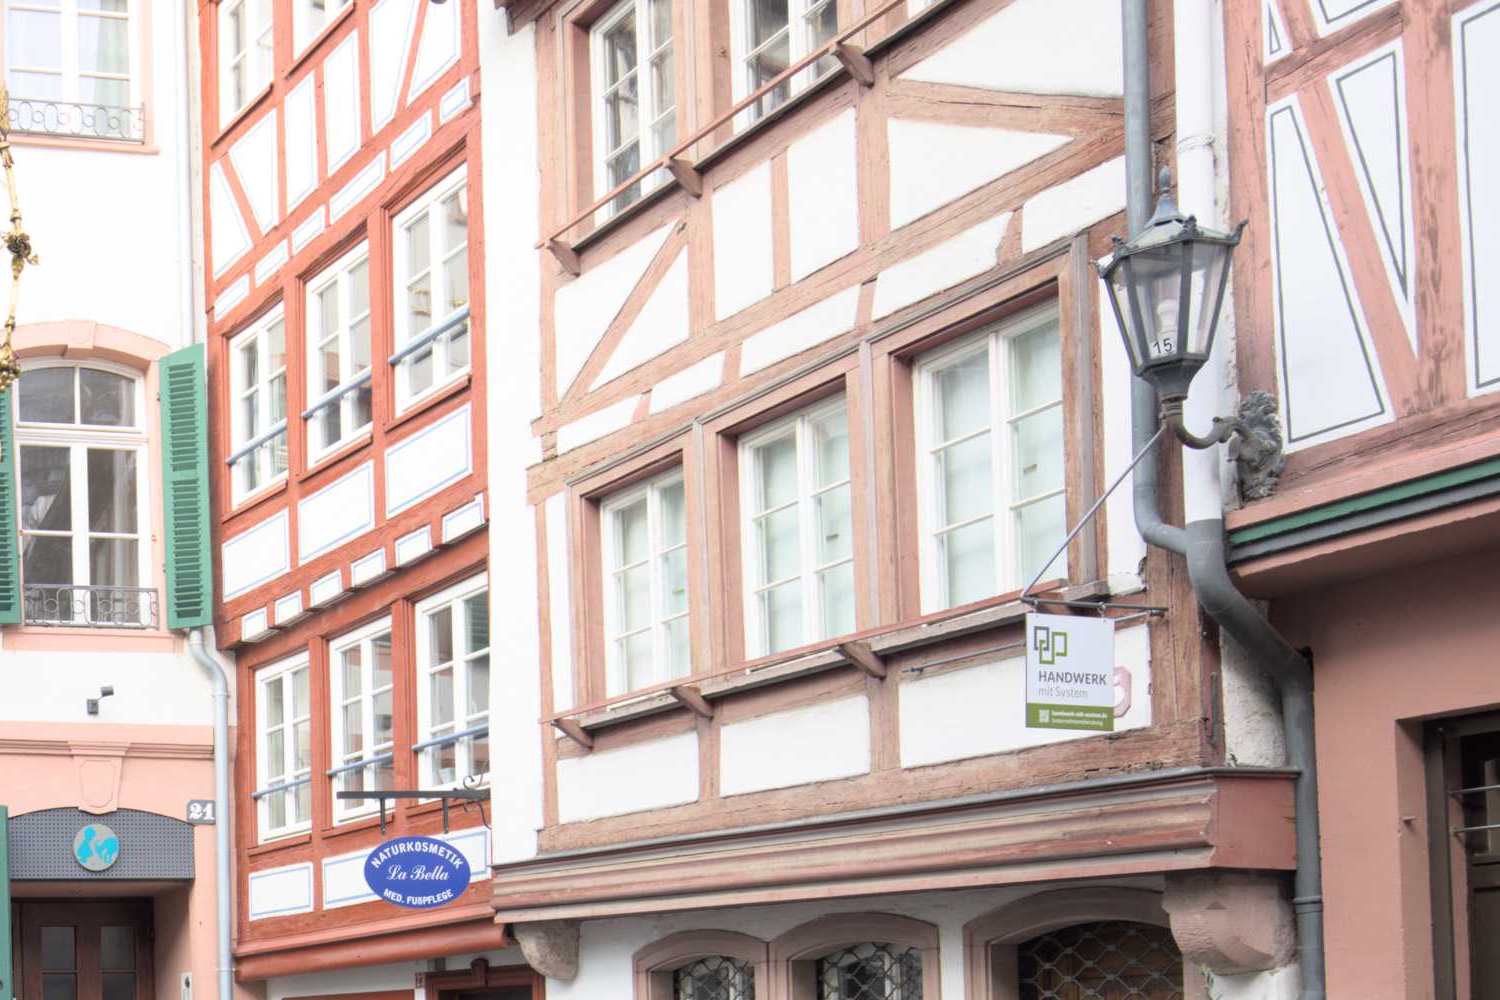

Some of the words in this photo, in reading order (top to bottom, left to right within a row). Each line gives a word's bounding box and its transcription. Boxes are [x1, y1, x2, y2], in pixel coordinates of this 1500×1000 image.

[1153, 338, 1173, 354] 15
[1038, 670, 1108, 686] HANDWERK
[1038, 686, 1053, 697] mit
[1055, 687, 1089, 699] System
[189, 802, 215, 820] 21
[371, 841, 465, 870] NATURKOSMETIK
[386, 864, 407, 881] La
[410, 864, 450, 881] Bella
[383, 887, 405, 904] MED.
